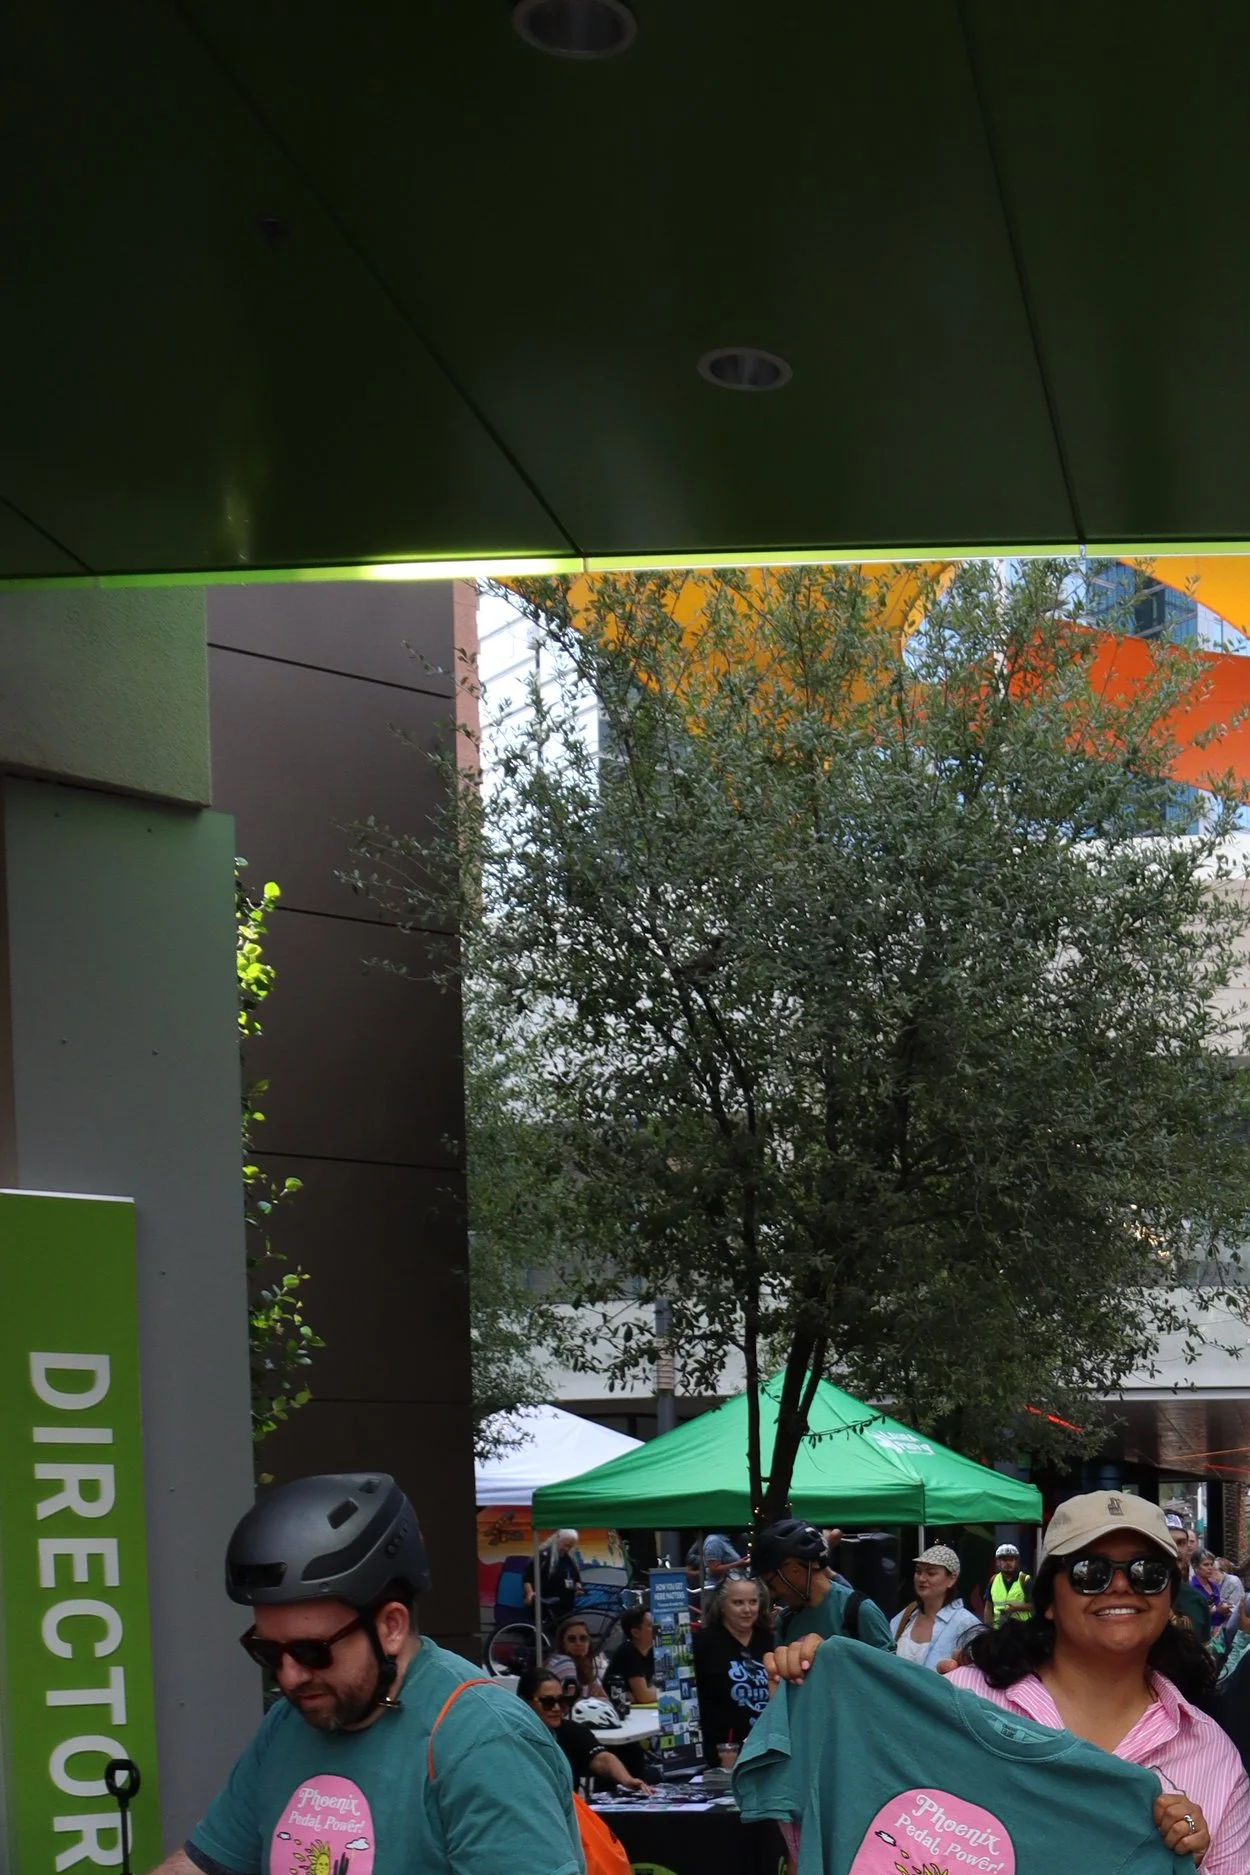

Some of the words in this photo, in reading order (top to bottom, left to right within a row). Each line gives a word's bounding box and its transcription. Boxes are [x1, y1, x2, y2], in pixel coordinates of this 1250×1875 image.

[288, 1811, 322, 1832] Pedal
[324, 1815, 366, 1834] Power!
[298, 1787, 361, 1816] Phoenix
[894, 1813, 941, 1856] Pedal
[943, 1842, 1005, 1875] Power!
[911, 1794, 1000, 1855] Phoenix
